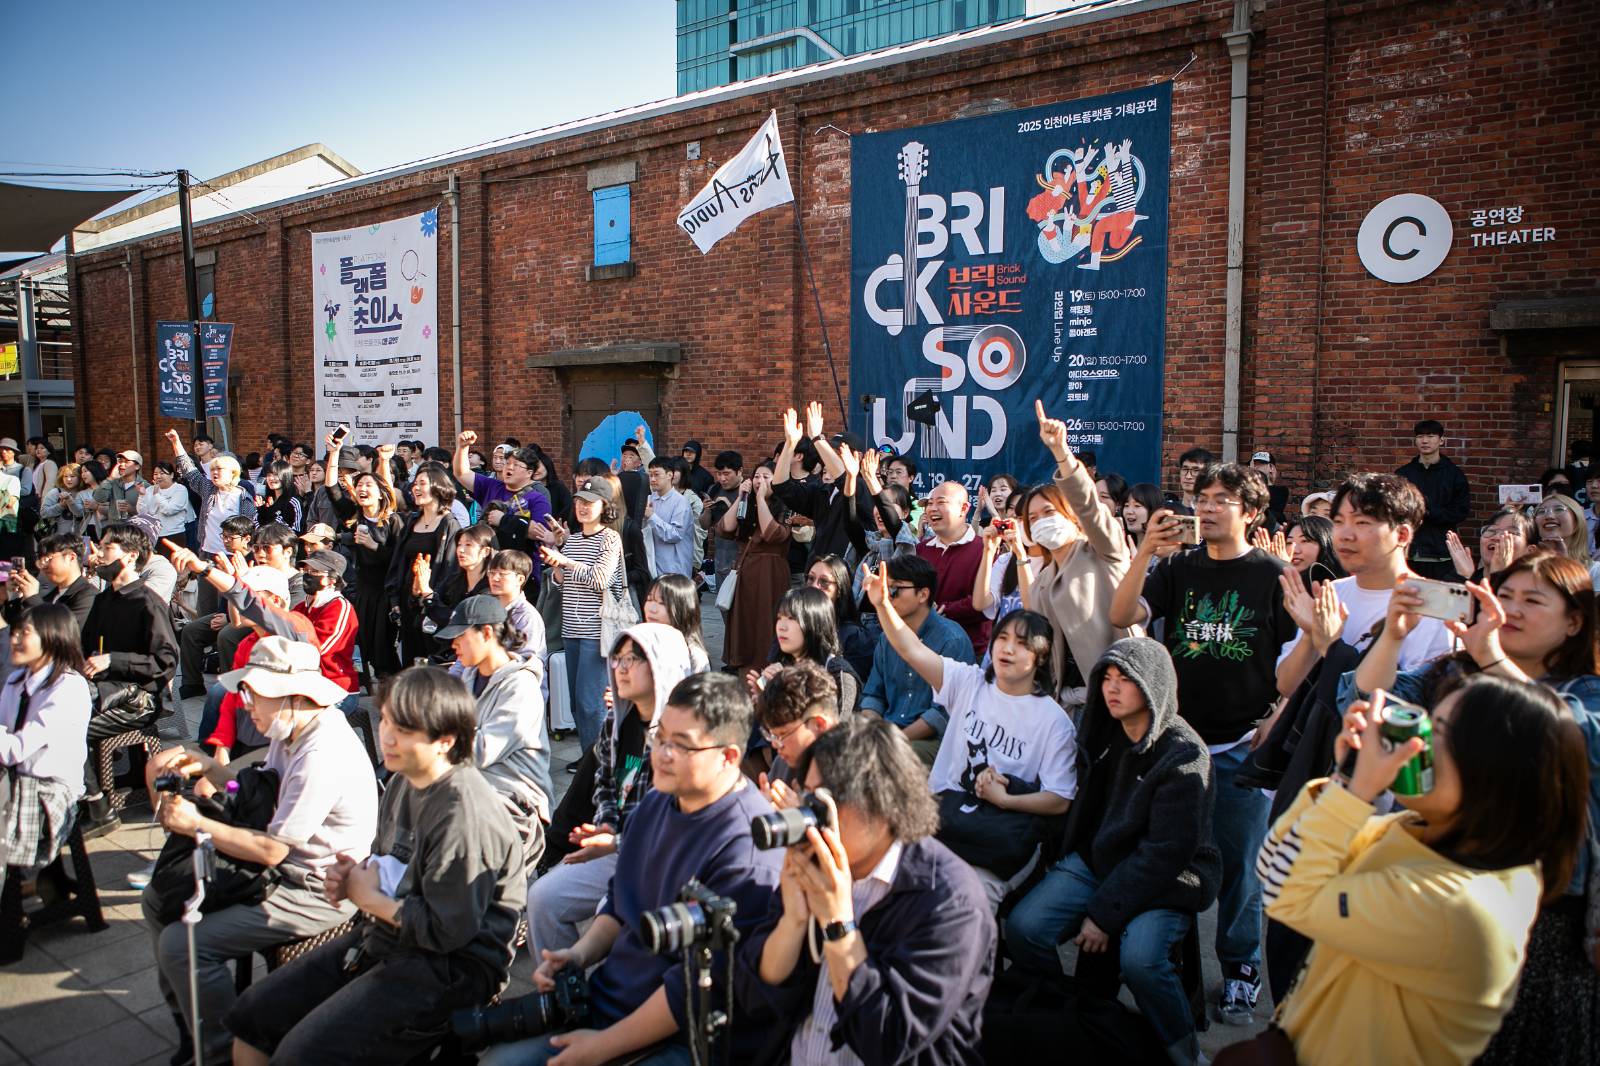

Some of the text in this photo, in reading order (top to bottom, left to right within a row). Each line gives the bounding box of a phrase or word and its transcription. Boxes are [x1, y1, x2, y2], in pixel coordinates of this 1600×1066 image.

[1018, 98, 1157, 133] 2025 인천아트플랫폼 기획공연
[916, 187, 1005, 259] BRI
[1470, 205, 1525, 227] 공연장
[1382, 215, 1427, 261] C
[1470, 227, 1556, 247] THEATER
[947, 264, 995, 290] 브릭
[996, 274, 1027, 285] Sound
[997, 264, 1021, 275] Brick
[948, 290, 1023, 316] 사운드
[1069, 287, 1146, 302] 19(토) 15:00~17:00
[353, 295, 403, 335] 초이스
[1069, 316, 1092, 327] minjo
[1051, 290, 1064, 363] 라인업 Line Up
[1068, 354, 1147, 366] 20(일) 15:00~17:00
[1066, 419, 1145, 431] 26(토) 15:00~17:00
[1080, 434, 1103, 444] 숫자들
[961, 474, 982, 491] 27
[1183, 619, 1235, 642] 言葉林
[988, 724, 1027, 761] DAYS
